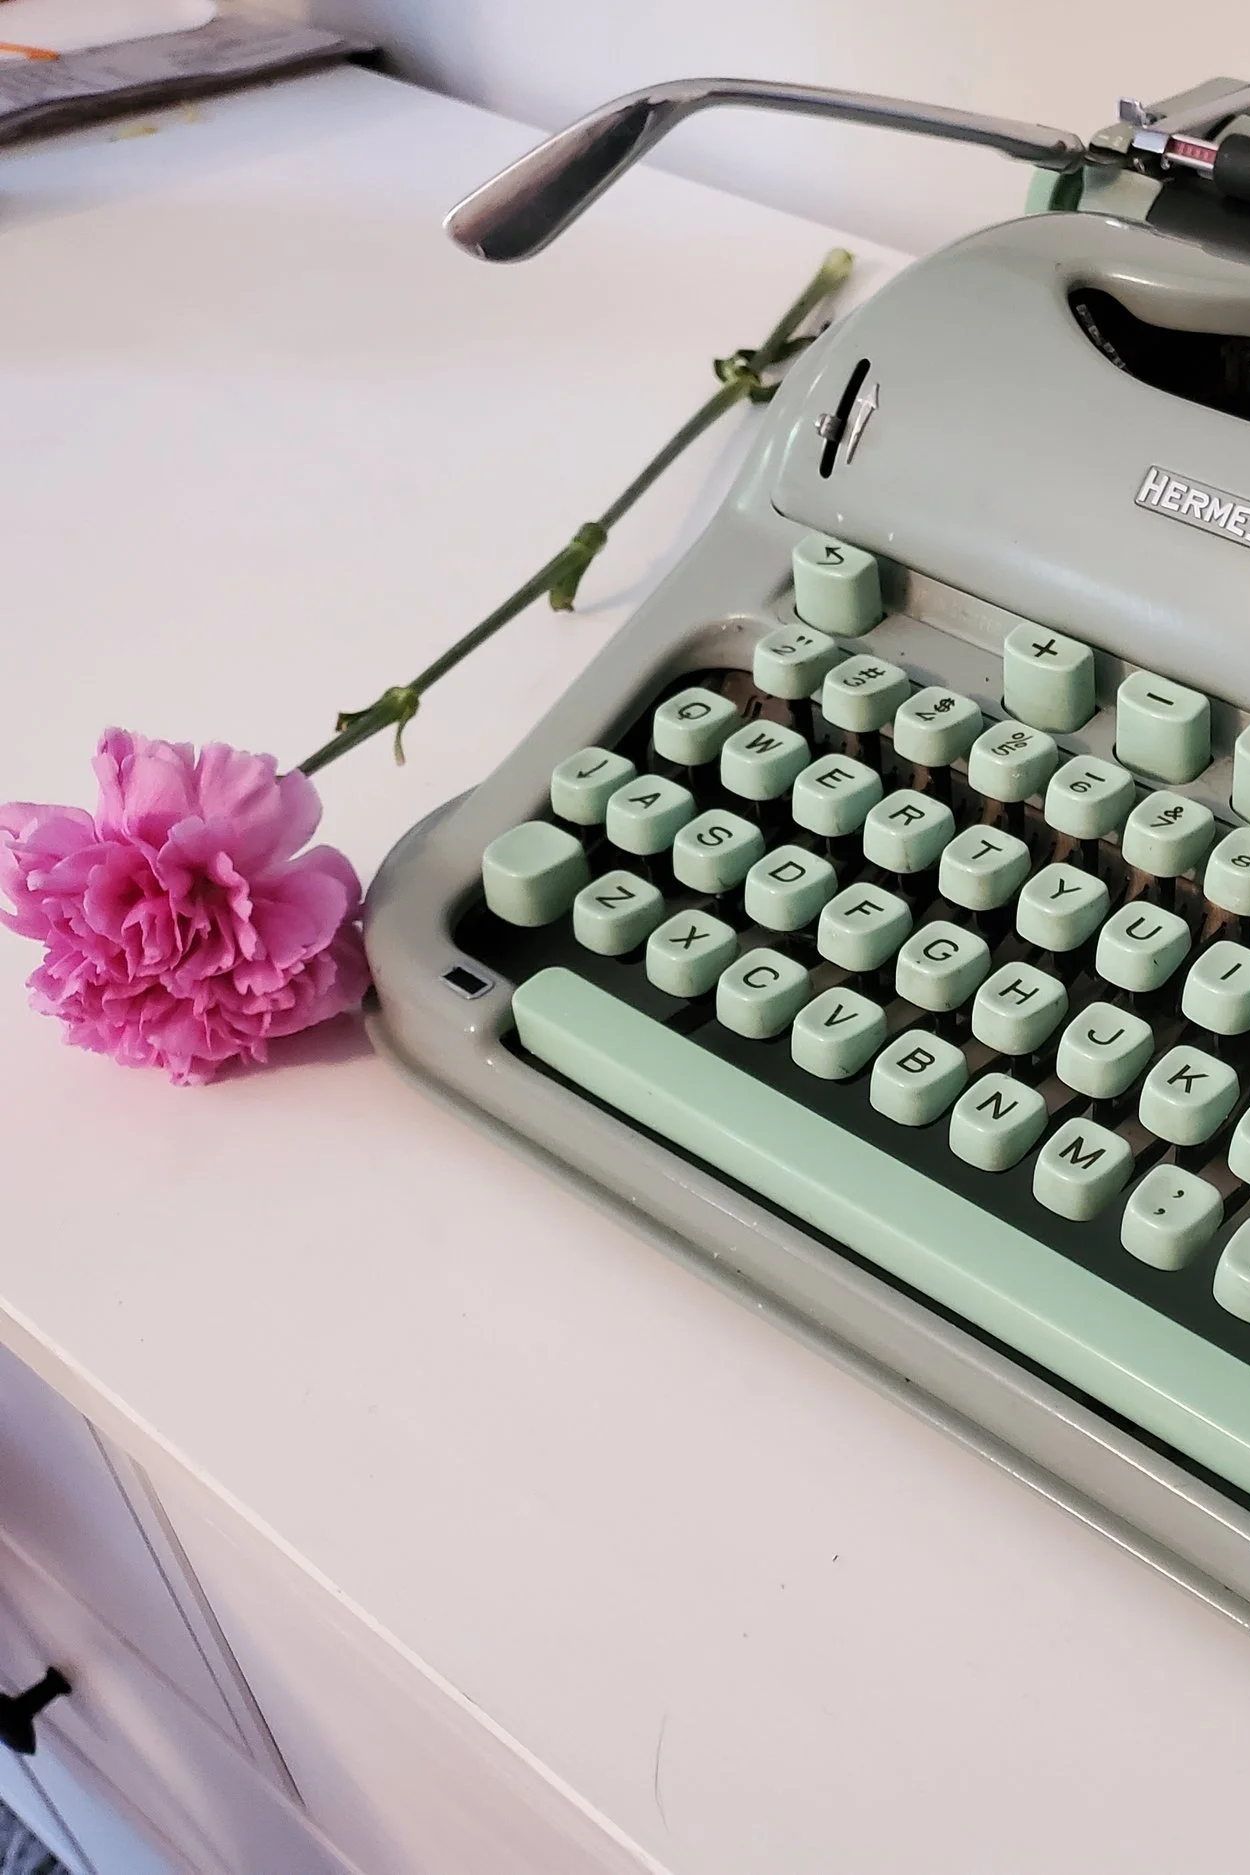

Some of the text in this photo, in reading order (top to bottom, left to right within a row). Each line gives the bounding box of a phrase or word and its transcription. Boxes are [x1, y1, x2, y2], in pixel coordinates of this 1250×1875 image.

[771, 645, 796, 656] 2
[843, 674, 866, 688] 3
[858, 667, 886, 680] #
[678, 703, 711, 720] Q
[934, 698, 955, 712] $
[914, 711, 937, 722] 4
[745, 733, 783, 753] W
[991, 743, 1015, 756] 5
[1007, 731, 1033, 749] %
[816, 768, 854, 789] E
[1070, 781, 1092, 793] 6
[628, 793, 661, 808] A
[889, 805, 925, 825] R
[1150, 814, 1174, 828] 7
[1164, 806, 1184, 821] &
[697, 827, 733, 846] S
[972, 840, 1002, 859] T
[768, 861, 806, 882] D
[595, 886, 635, 909] Z
[1050, 879, 1081, 899] Y
[844, 900, 884, 916] F
[669, 926, 709, 949] X
[1126, 917, 1162, 940] U
[922, 938, 960, 962] G
[743, 967, 779, 988] C
[998, 979, 1039, 1005] H
[824, 1004, 858, 1027] V
[1088, 1029, 1124, 1045] J
[896, 1047, 935, 1073] B
[1167, 1065, 1208, 1093] K
[976, 1091, 1018, 1119] N
[1059, 1136, 1106, 1169] M
